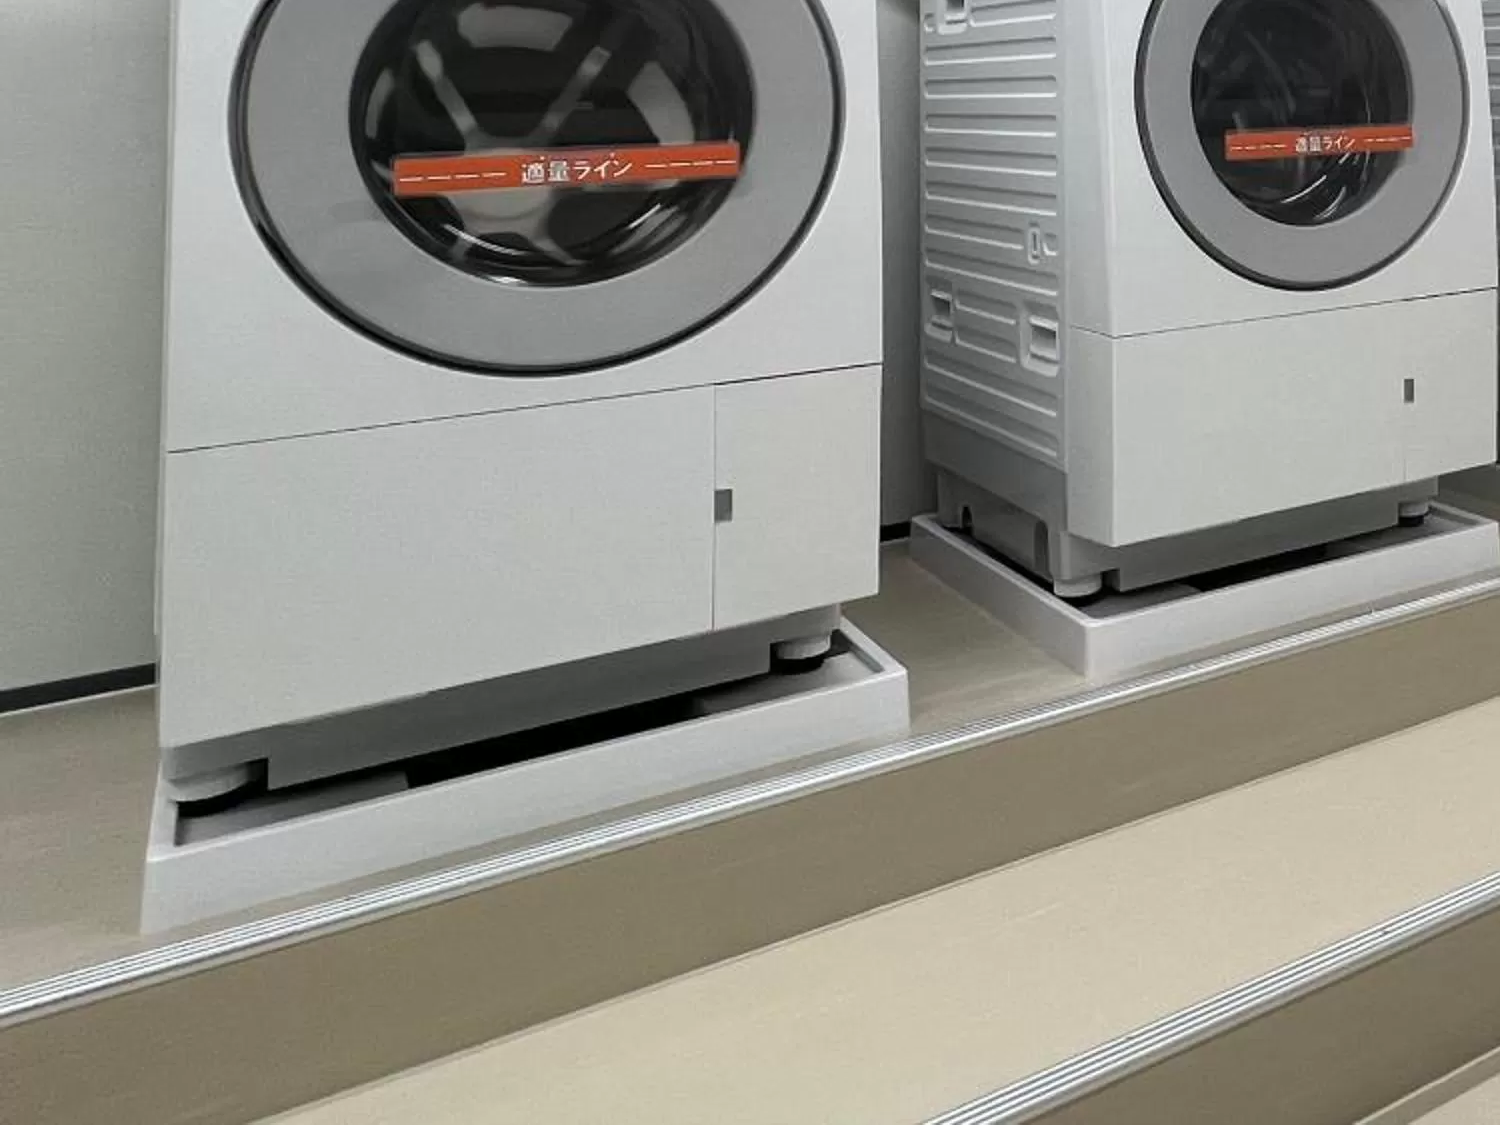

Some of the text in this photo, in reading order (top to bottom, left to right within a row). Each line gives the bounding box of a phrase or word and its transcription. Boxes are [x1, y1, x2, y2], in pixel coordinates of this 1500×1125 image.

[521, 151, 633, 184] 適量ライン
